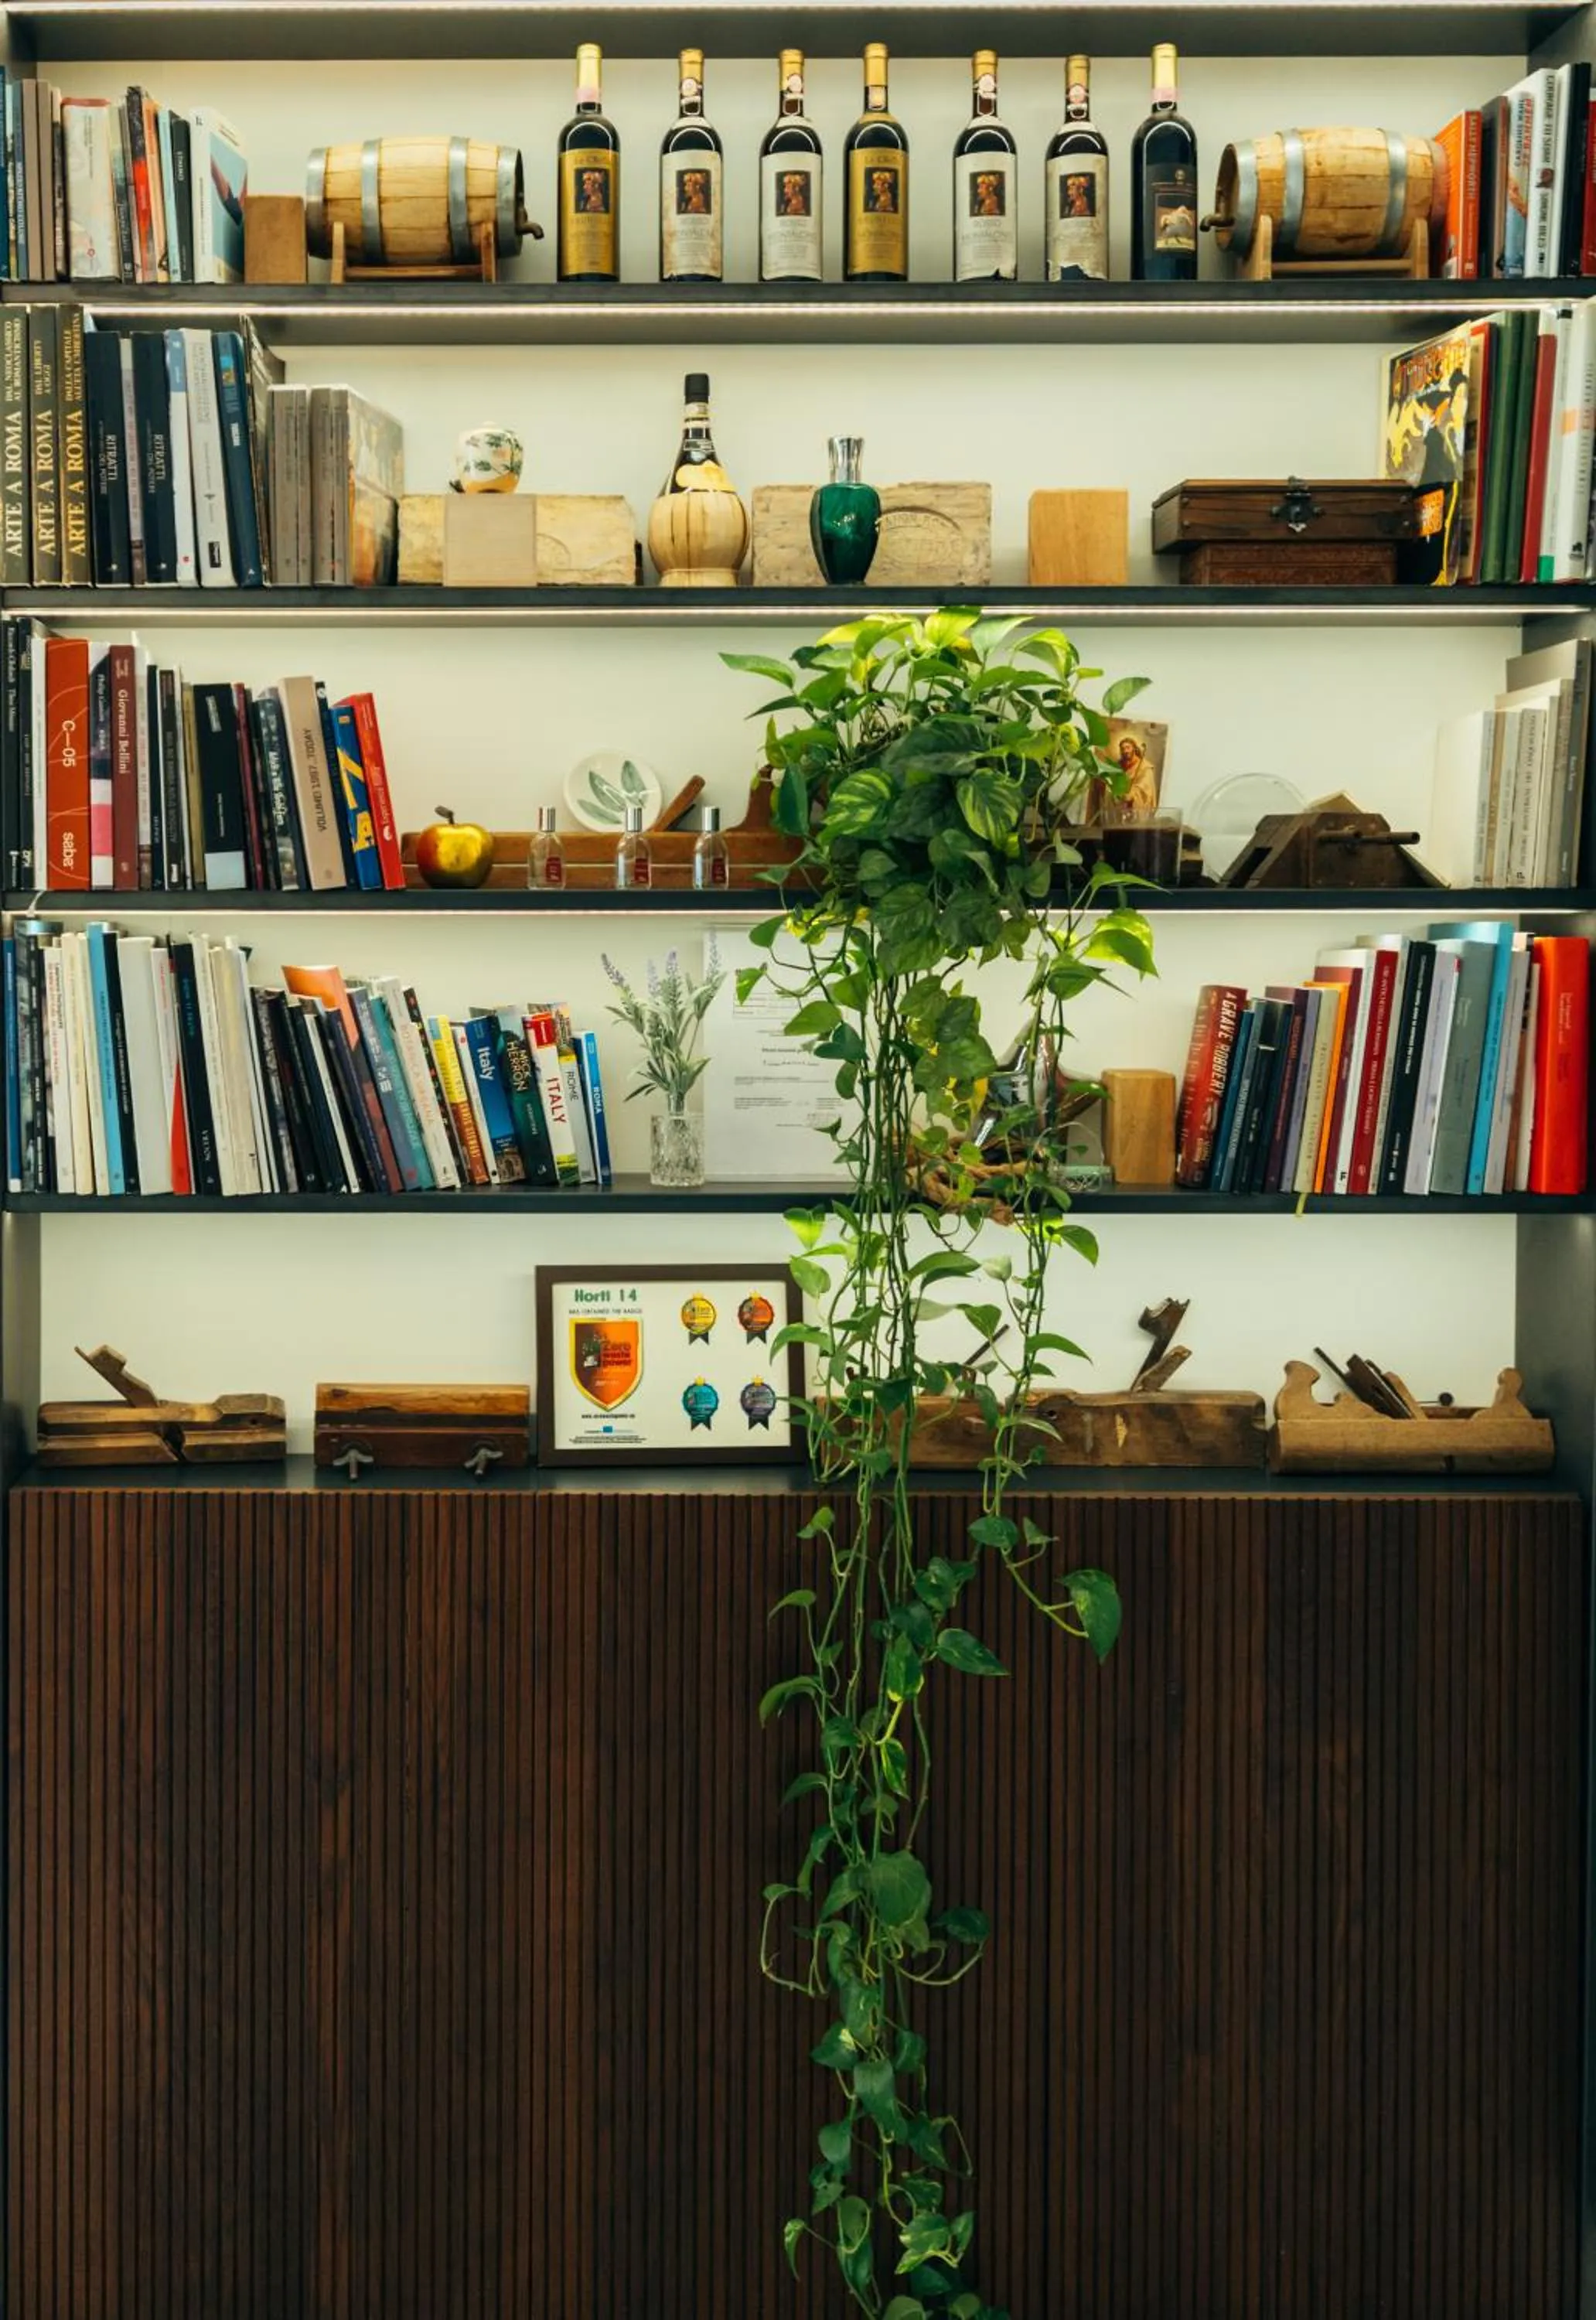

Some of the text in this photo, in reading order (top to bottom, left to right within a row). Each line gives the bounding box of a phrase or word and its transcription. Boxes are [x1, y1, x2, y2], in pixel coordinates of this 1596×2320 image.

[105, 434, 117, 480] RITRATTI
[154, 434, 165, 480] RITRATTI
[5, 411, 22, 557] ARTE A ROMA
[36, 410, 56, 556] ARTE A ROMA
[66, 410, 86, 557] ARTE A ROMA
[118, 689, 130, 736] Giovanni
[118, 740, 131, 773] Bellini
[476, 1046, 497, 1080] Italy
[506, 1042, 528, 1092] HERRON
[517, 1049, 532, 1078] MICK
[1211, 991, 1236, 1098] A GRAVE ROBBERY
[546, 1076, 567, 1124] ITALY
[565, 1071, 579, 1101] ROME
[575, 1289, 638, 1302] Horti 14
